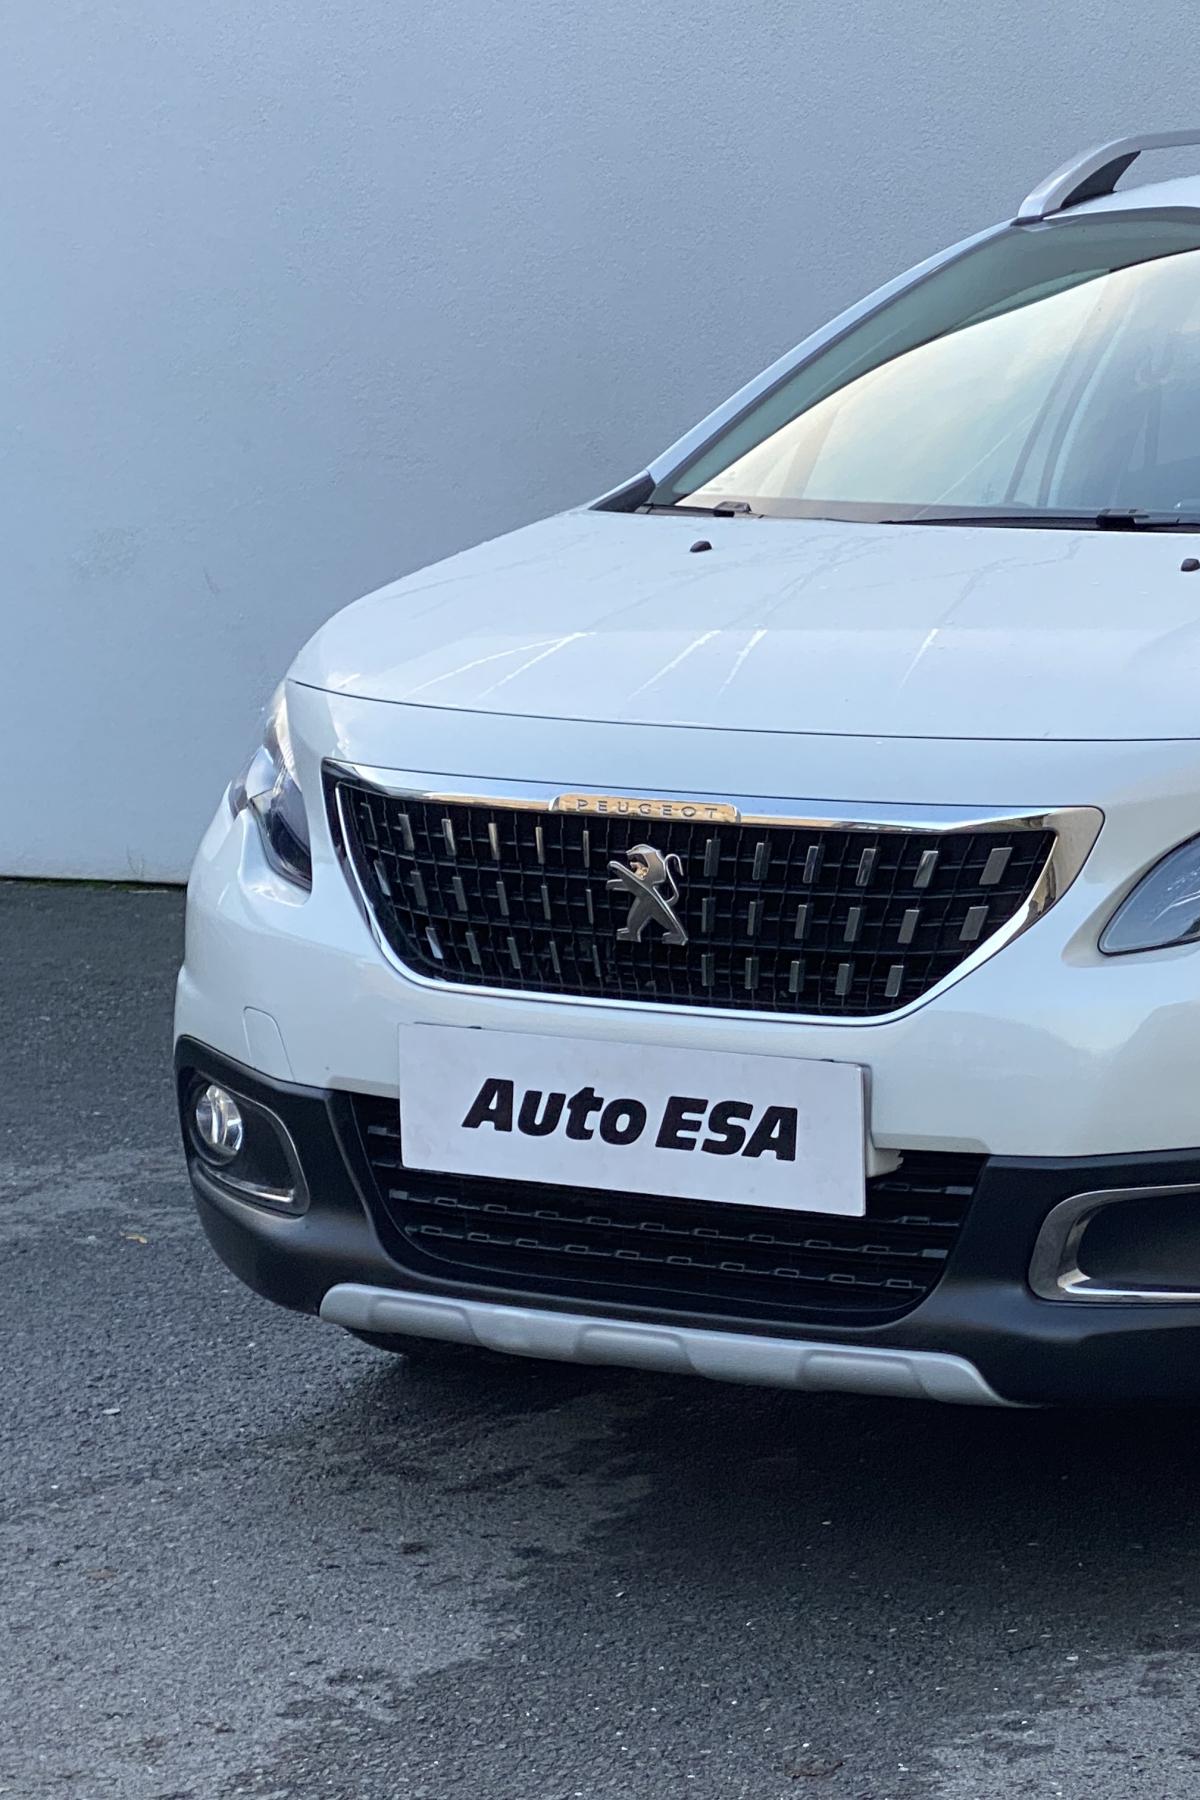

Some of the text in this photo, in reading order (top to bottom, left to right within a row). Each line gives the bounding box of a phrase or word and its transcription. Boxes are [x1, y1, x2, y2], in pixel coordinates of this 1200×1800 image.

[576, 799, 718, 819] PEUGEOT
[462, 1078, 798, 1162] Auto ESA
